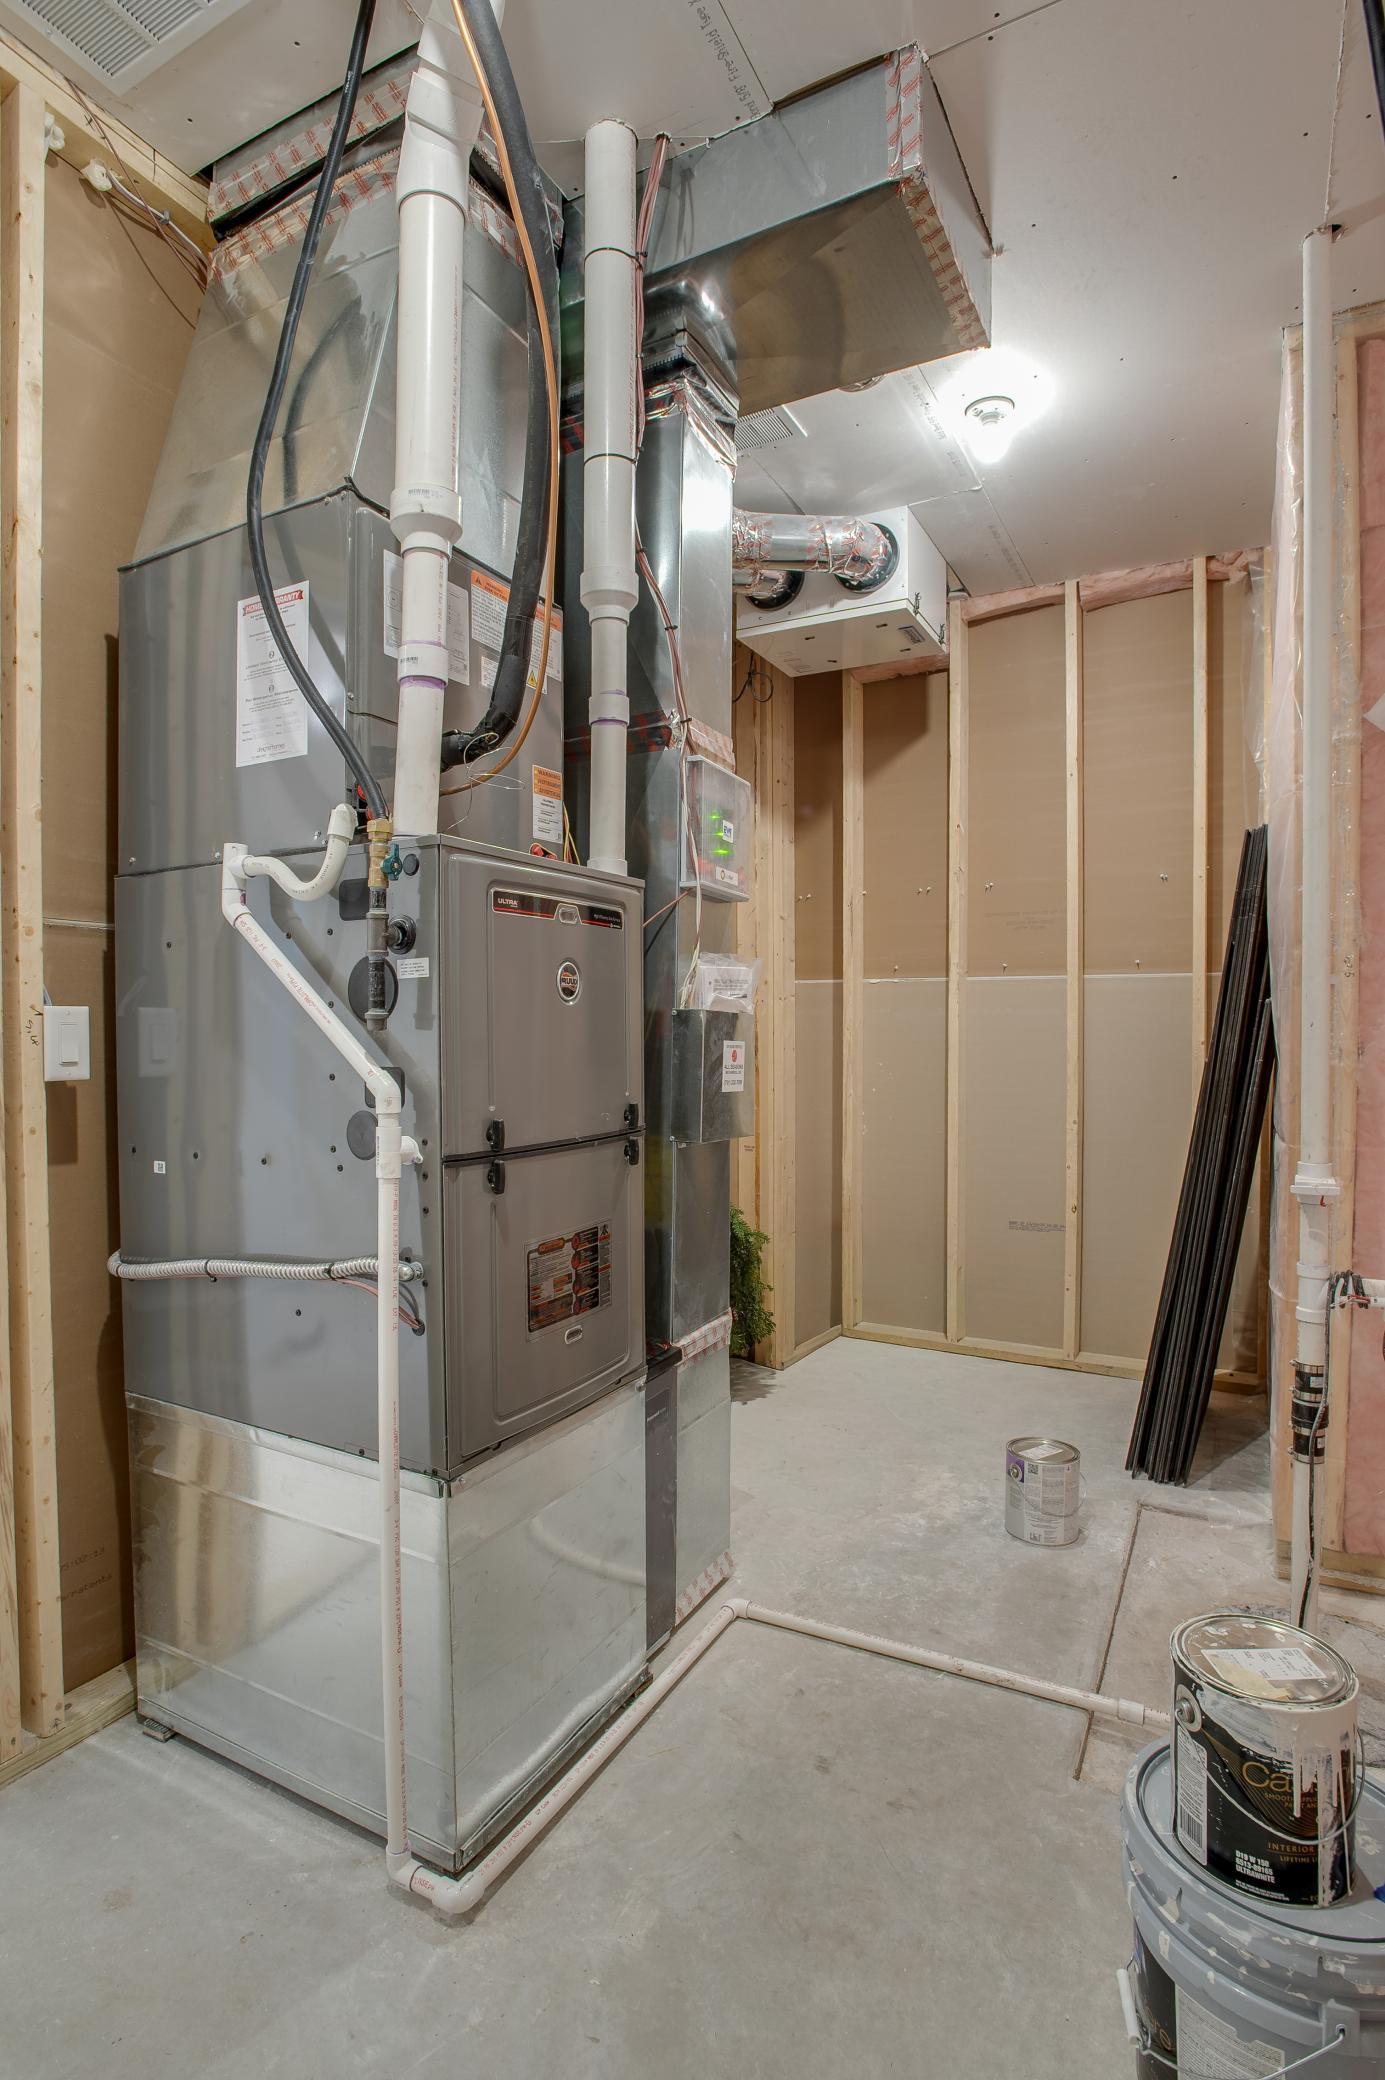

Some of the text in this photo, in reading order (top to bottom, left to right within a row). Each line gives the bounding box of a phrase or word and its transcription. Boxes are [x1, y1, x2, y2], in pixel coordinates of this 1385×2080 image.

[696, 5, 713, 31] Type
[705, 29, 739, 83] Fire-Shield
[497, 897, 518, 906] ULTRA
[561, 977, 578, 986] RUUD
[1268, 1841, 1314, 1853] INTERIOR
[1279, 1854, 1309, 1863] LIFETIME
[1235, 1865, 1276, 1884] ULTRAWHITE
